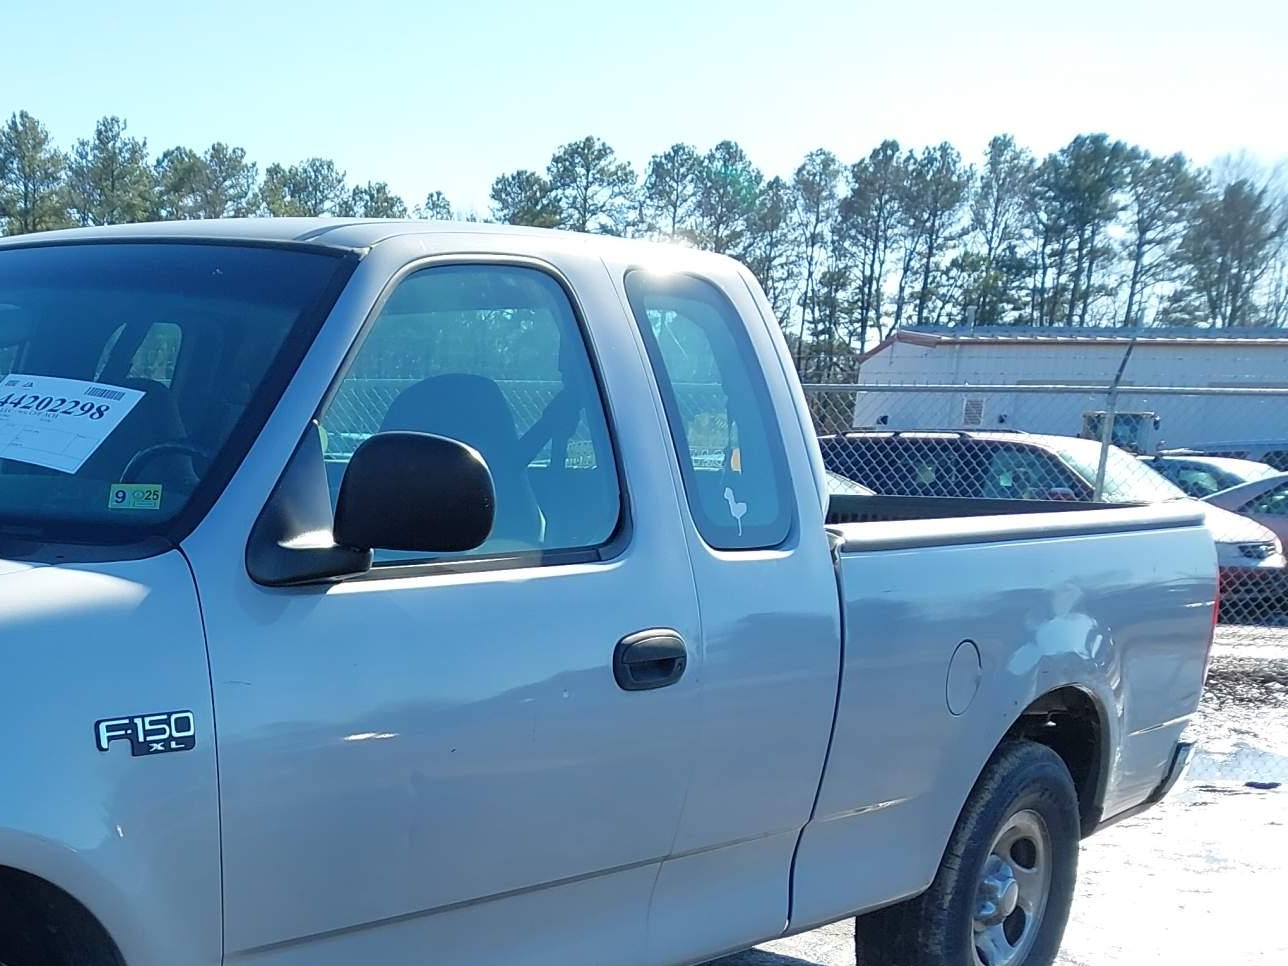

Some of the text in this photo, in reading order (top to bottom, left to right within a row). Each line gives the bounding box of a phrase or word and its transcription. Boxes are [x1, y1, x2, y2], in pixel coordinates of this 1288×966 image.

[115, 489, 127, 504] 9
[144, 489, 160, 501] 25
[98, 711, 195, 749] F-150
[148, 740, 185, 752] XL
